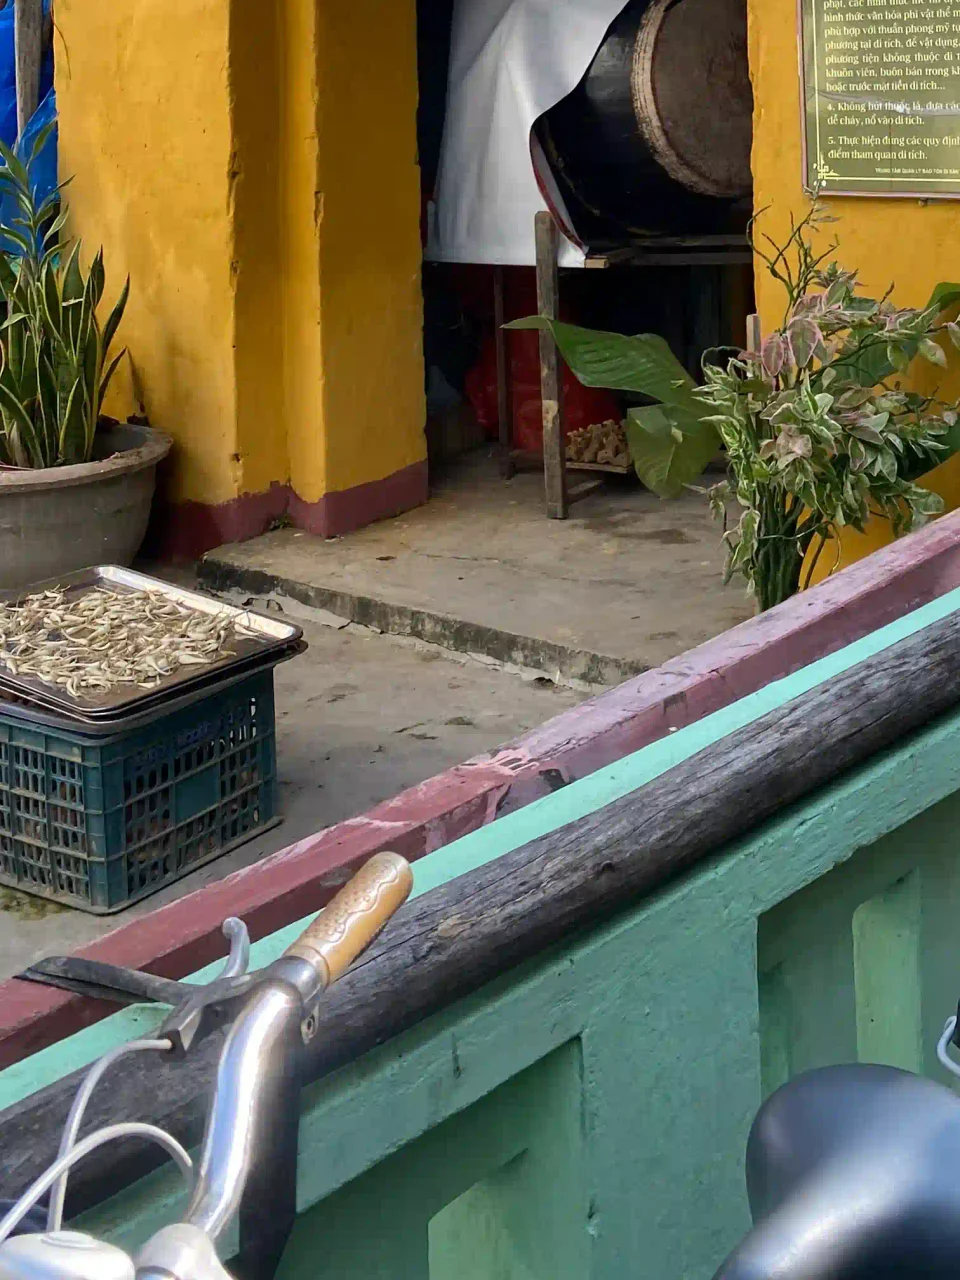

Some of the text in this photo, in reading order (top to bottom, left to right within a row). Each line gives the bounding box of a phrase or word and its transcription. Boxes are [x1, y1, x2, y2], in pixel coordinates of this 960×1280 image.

[824, 10, 843, 21] hình
[845, 9, 864, 21] thức
[867, 10, 883, 20] văn
[885, 8, 902, 20] hóa
[904, 9, 918, 21] phi
[920, 7, 934, 19] vật
[936, 6, 951, 17] thể
[825, 27, 842, 37] phù
[844, 25, 860, 37] hợp
[863, 24, 876, 34] với
[878, 23, 903, 33] thuần
[905, 23, 934, 35] phong
[936, 23, 950, 33] mỹ
[825, 40, 858, 51] phương
[860, 39, 872, 49] tại
[874, 39, 883, 48] di
[906, 34, 917, 47] để
[919, 36, 933, 47] vật
[935, 35, 960, 48] dụng,
[826, 54, 859, 65] phương
[862, 52, 879, 63] tiện
[883, 52, 911, 64] không
[914, 50, 940, 62] thuộc
[944, 51, 954, 60] di
[826, 66, 853, 77] khuôn
[856, 67, 877, 77] viên,
[880, 65, 903, 76] buôn
[906, 65, 923, 75] bán
[925, 65, 949, 76] trong
[827, 78, 945, 91] hoặc trước mặt tiền di tích...
[827, 103, 835, 111] 4.
[837, 101, 866, 112] Không
[868, 101, 883, 111] hút
[827, 113, 925, 126] dễ cháy, nổ vào di tích.
[838, 136, 859, 146] Thực
[862, 136, 881, 146] hiện
[907, 136, 921, 145] các
[923, 137, 940, 147] quy
[828, 149, 927, 160] điểm tham quan di tích.
